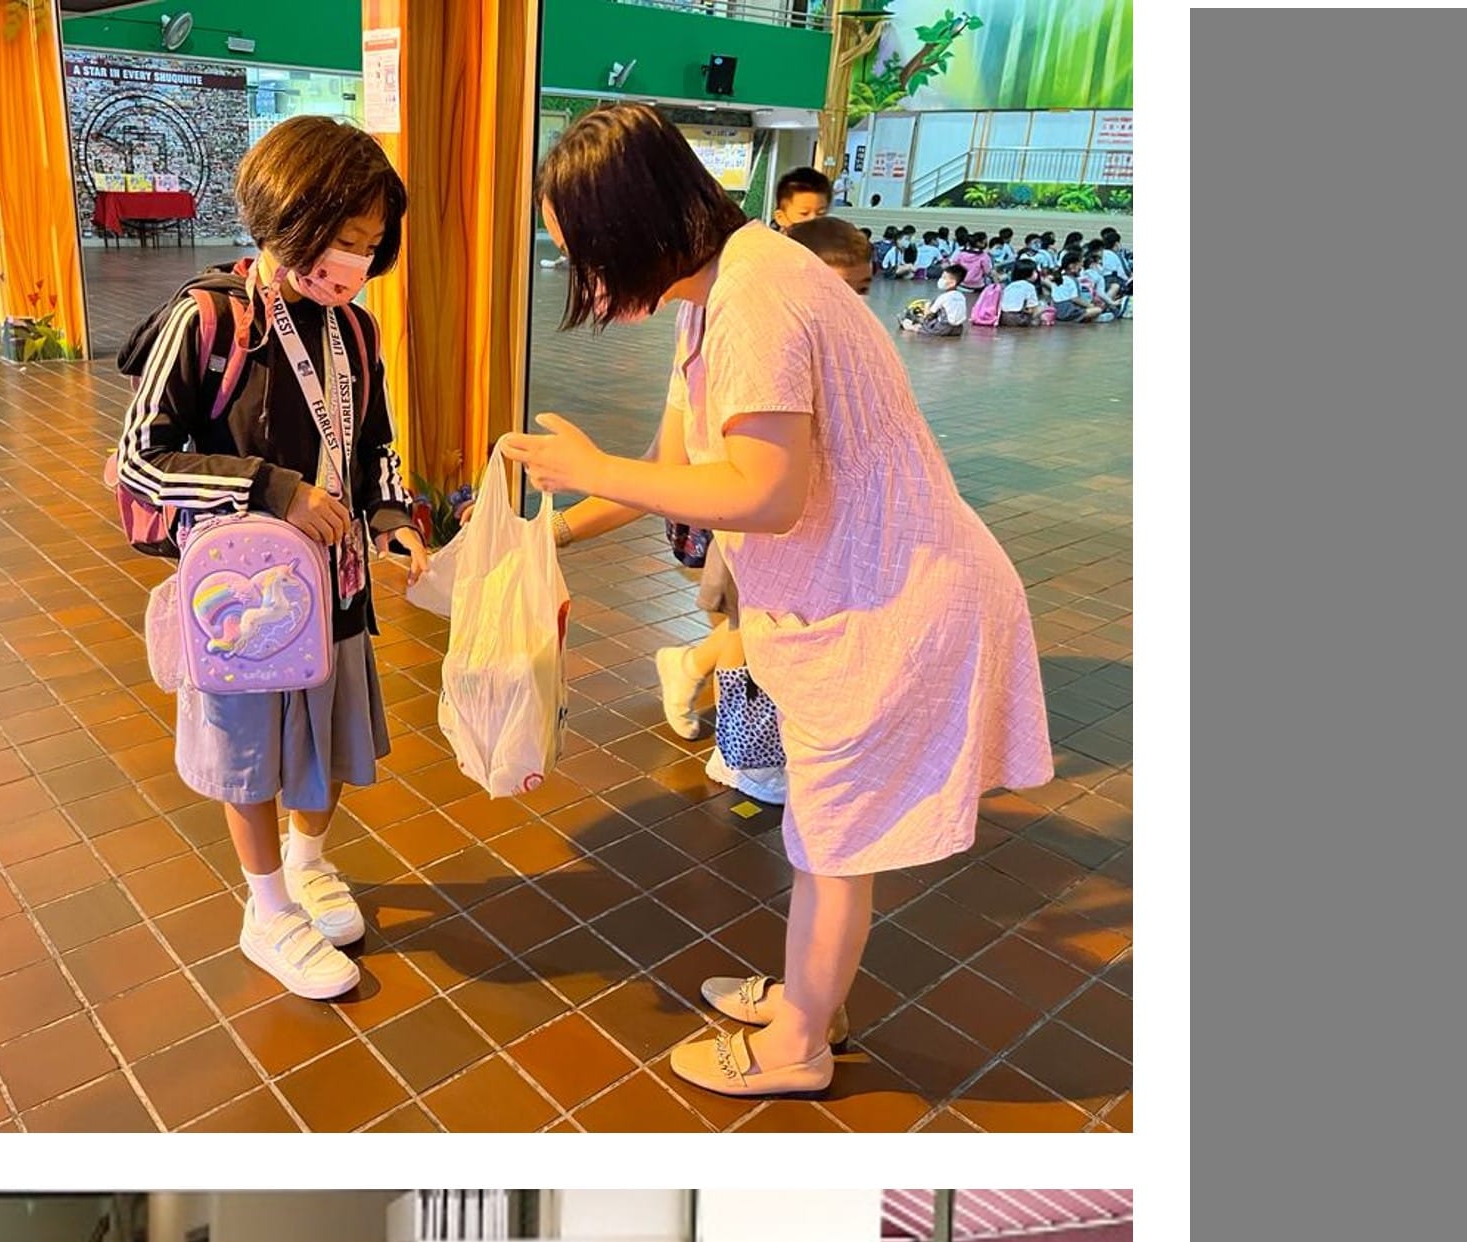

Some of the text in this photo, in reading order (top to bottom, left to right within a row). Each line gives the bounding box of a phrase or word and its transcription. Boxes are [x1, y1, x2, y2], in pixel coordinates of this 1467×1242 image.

[73, 65, 81, 75] A
[83, 66, 107, 77] STAR
[110, 69, 120, 78] IN
[123, 71, 152, 81] EVERY
[331, 332, 344, 355] LIVE
[313, 399, 340, 451] FEARLEST
